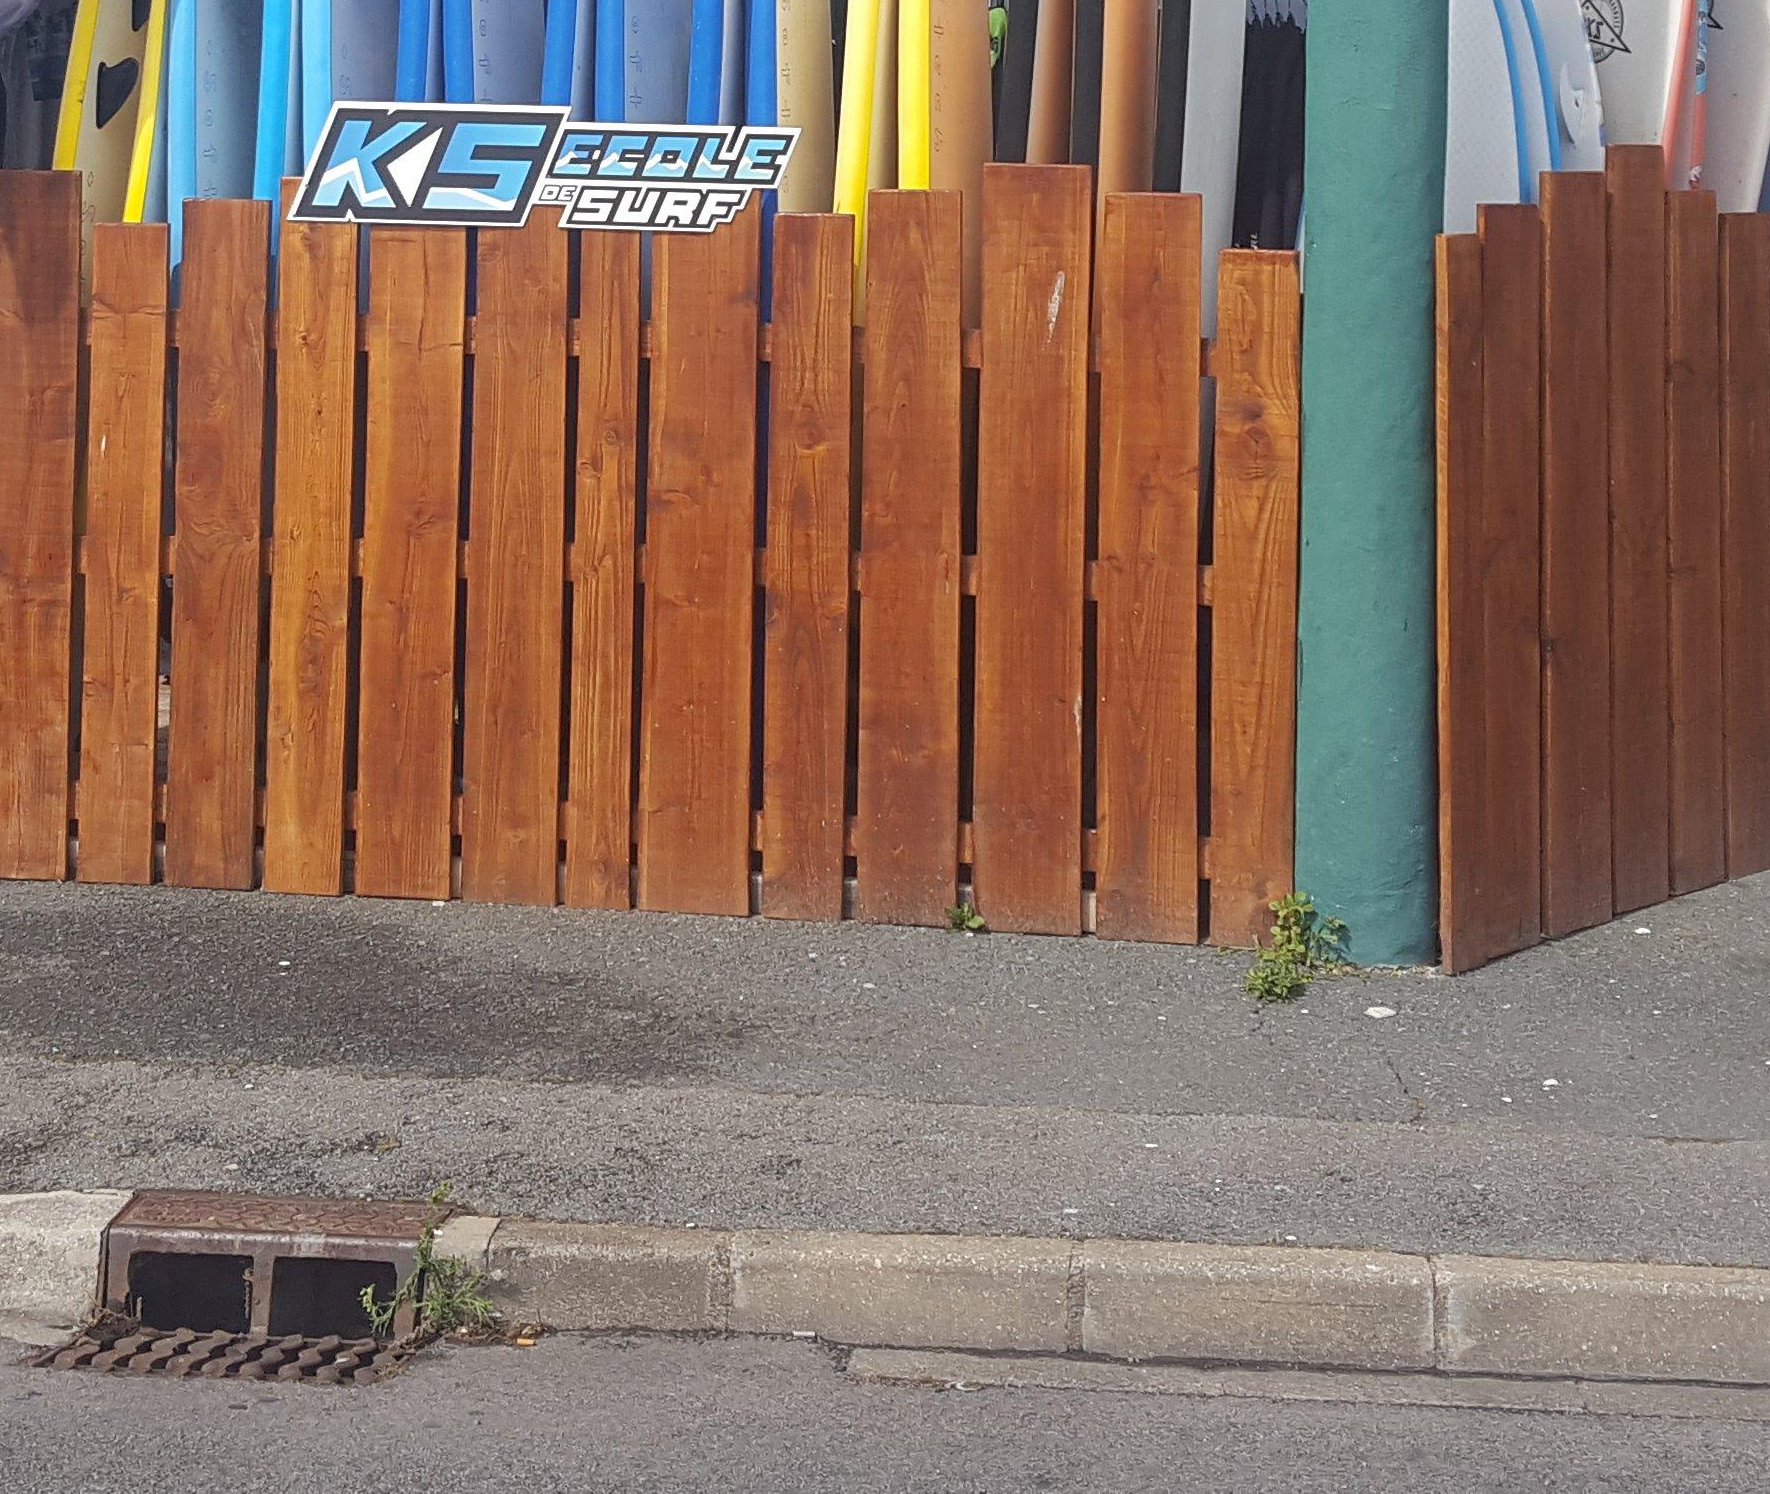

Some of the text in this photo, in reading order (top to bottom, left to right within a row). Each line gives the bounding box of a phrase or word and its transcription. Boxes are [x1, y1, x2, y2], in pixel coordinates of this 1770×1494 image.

[312, 120, 786, 210] KS ECOLE
[540, 185, 742, 226] DE SURF
